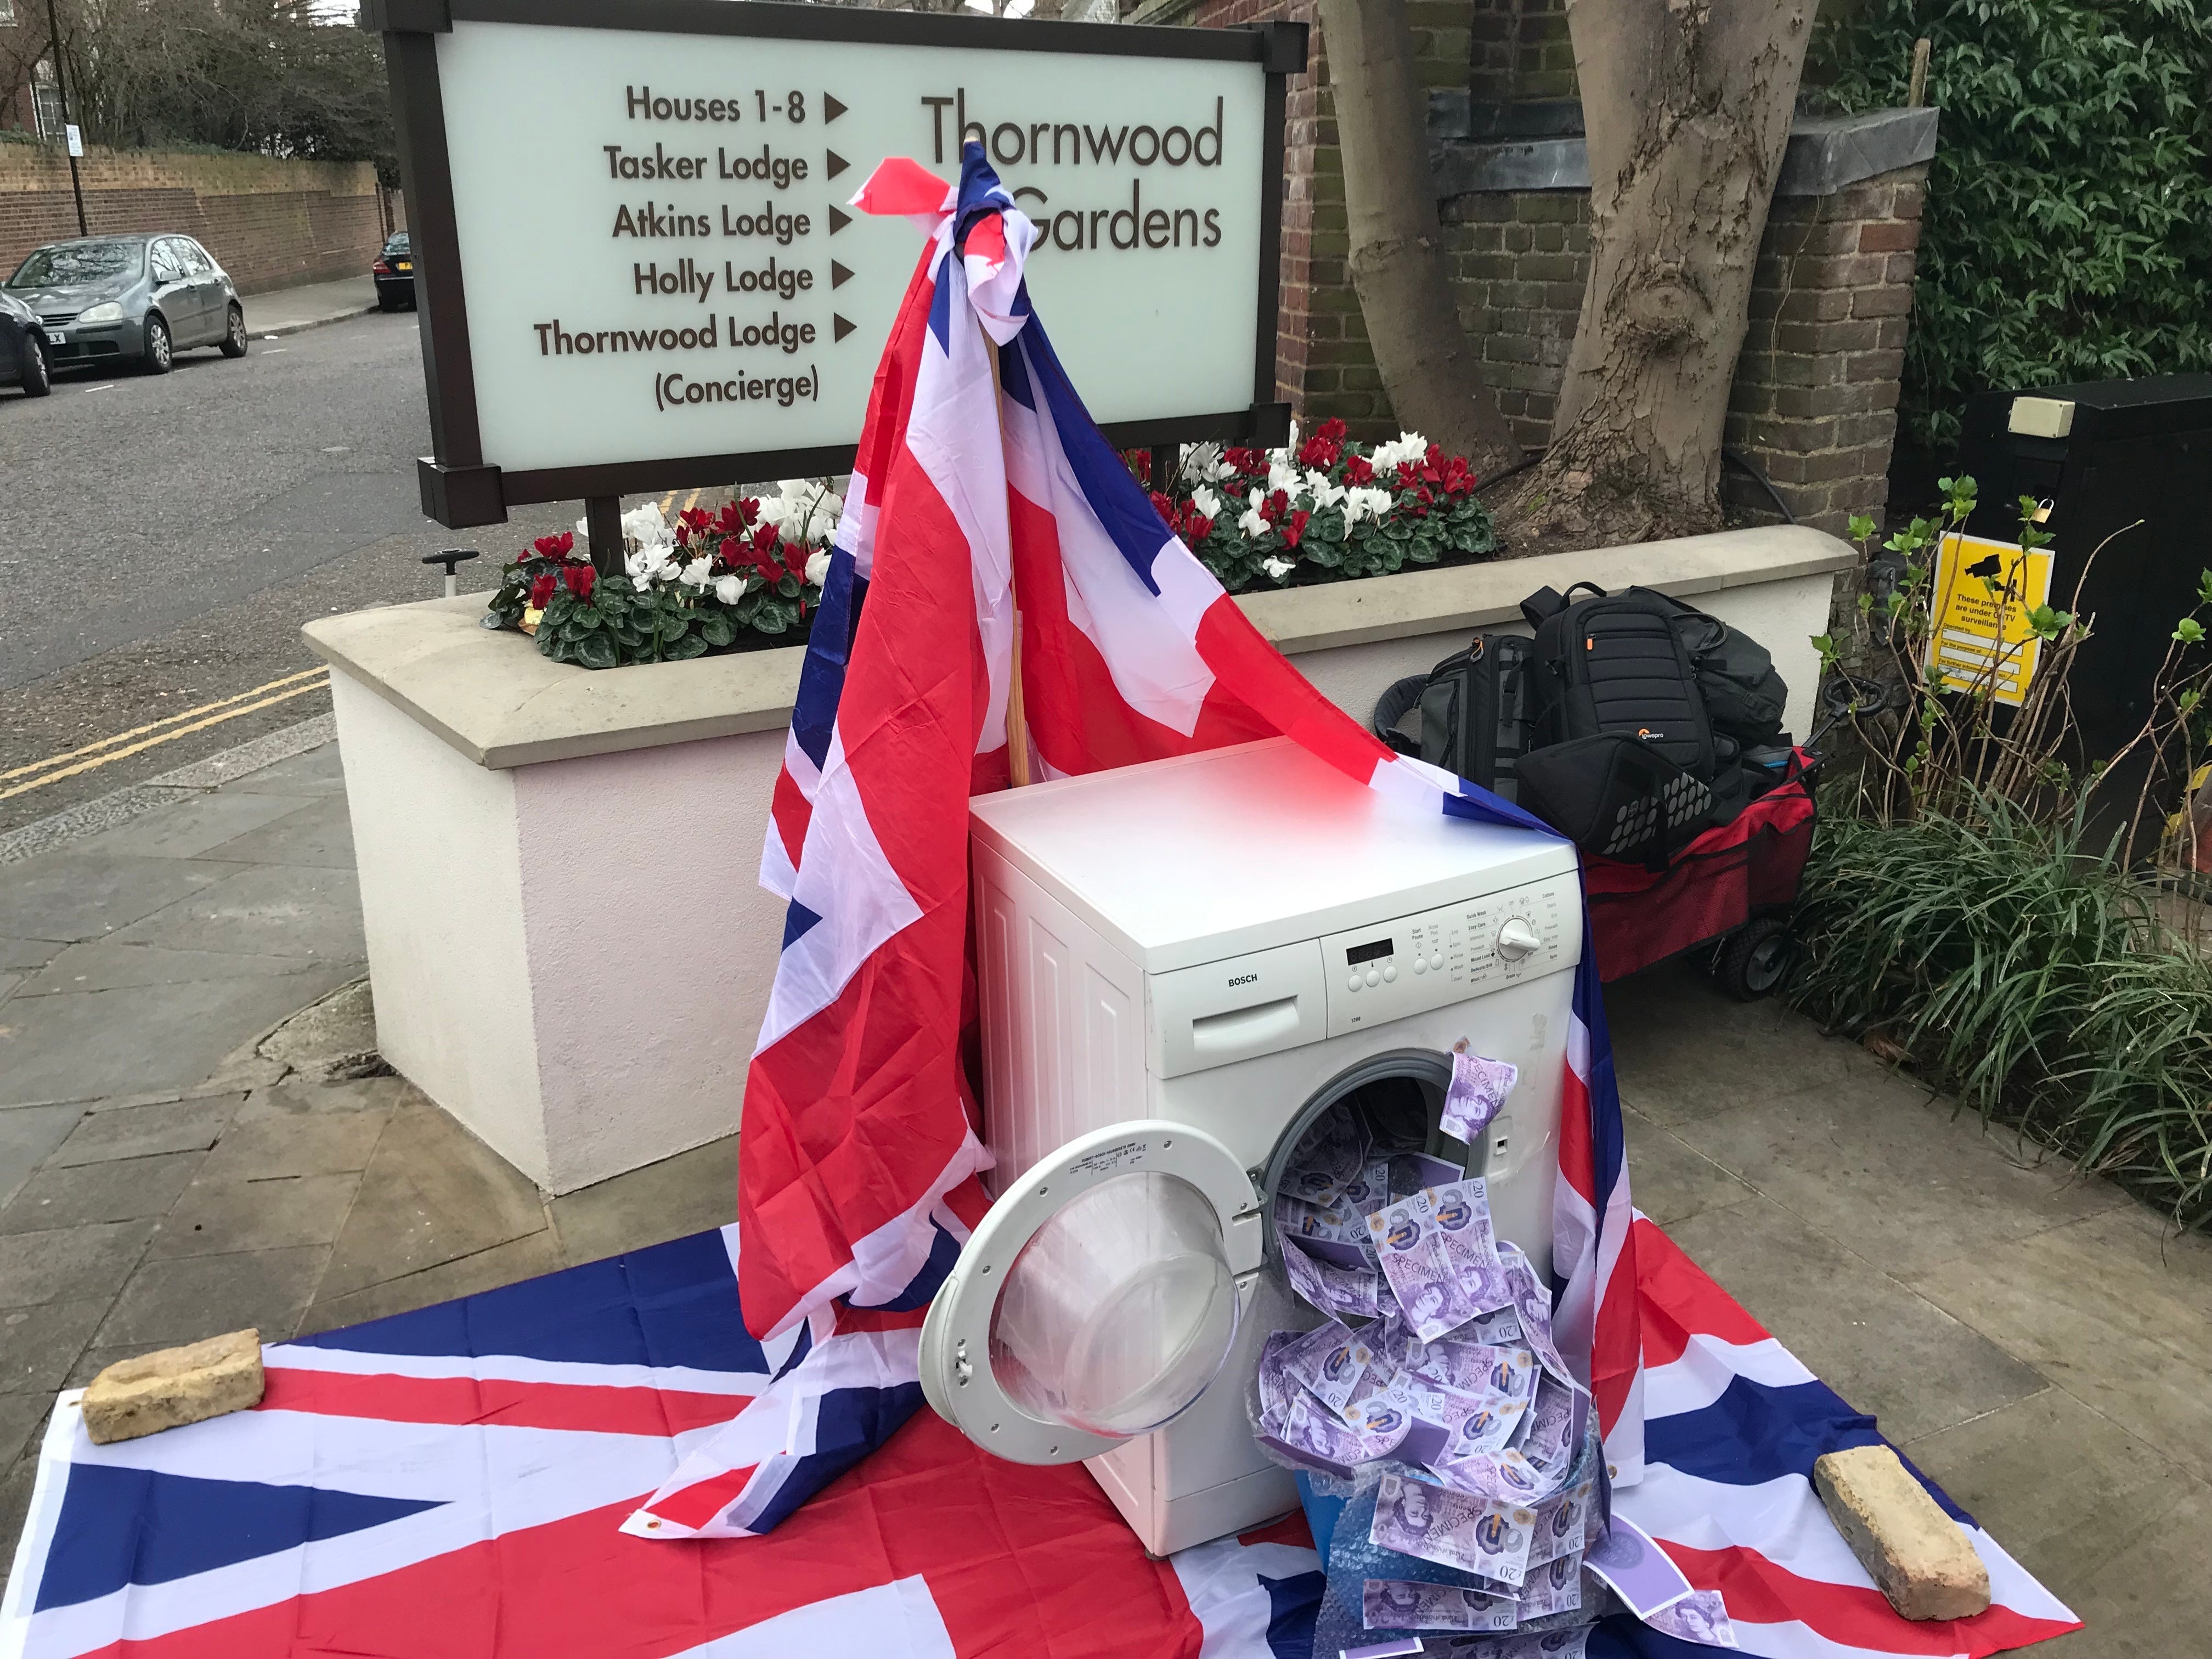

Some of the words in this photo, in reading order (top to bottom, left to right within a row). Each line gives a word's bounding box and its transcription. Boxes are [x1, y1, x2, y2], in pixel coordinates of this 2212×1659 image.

[627, 86, 741, 122] Houses
[755, 90, 805, 123] 1-8
[921, 88, 1223, 166] Thornwood
[603, 143, 707, 179] Tasker
[719, 144, 808, 189] Lodge
[612, 201, 710, 238] Atkins
[723, 201, 810, 245] Lodge
[634, 258, 714, 303] Holly
[726, 257, 812, 300] Lodge
[48, 334, 61, 343] LX
[534, 314, 717, 356] Thornwood
[729, 311, 816, 353] Lodge
[656, 364, 819, 411] (Concierge)
[1957, 594, 1979, 605] These
[1981, 600, 2017, 612] premses
[1969, 608, 1991, 617] under
[1993, 612, 2016, 622] CTV
[1961, 616, 2007, 630] surveillane
[1228, 973, 1257, 987] BOSCH
[1416, 1196, 1429, 1213] £20
[1473, 1180, 1485, 1198] £20
[1393, 1252, 1446, 1283] SPECIMEN
[1455, 1357, 1493, 1390] SPECIM
[1423, 1505, 1482, 1544] SPECIMEN
[1499, 1565, 1523, 1580] £20
[1493, 1615, 1514, 1627] £20
